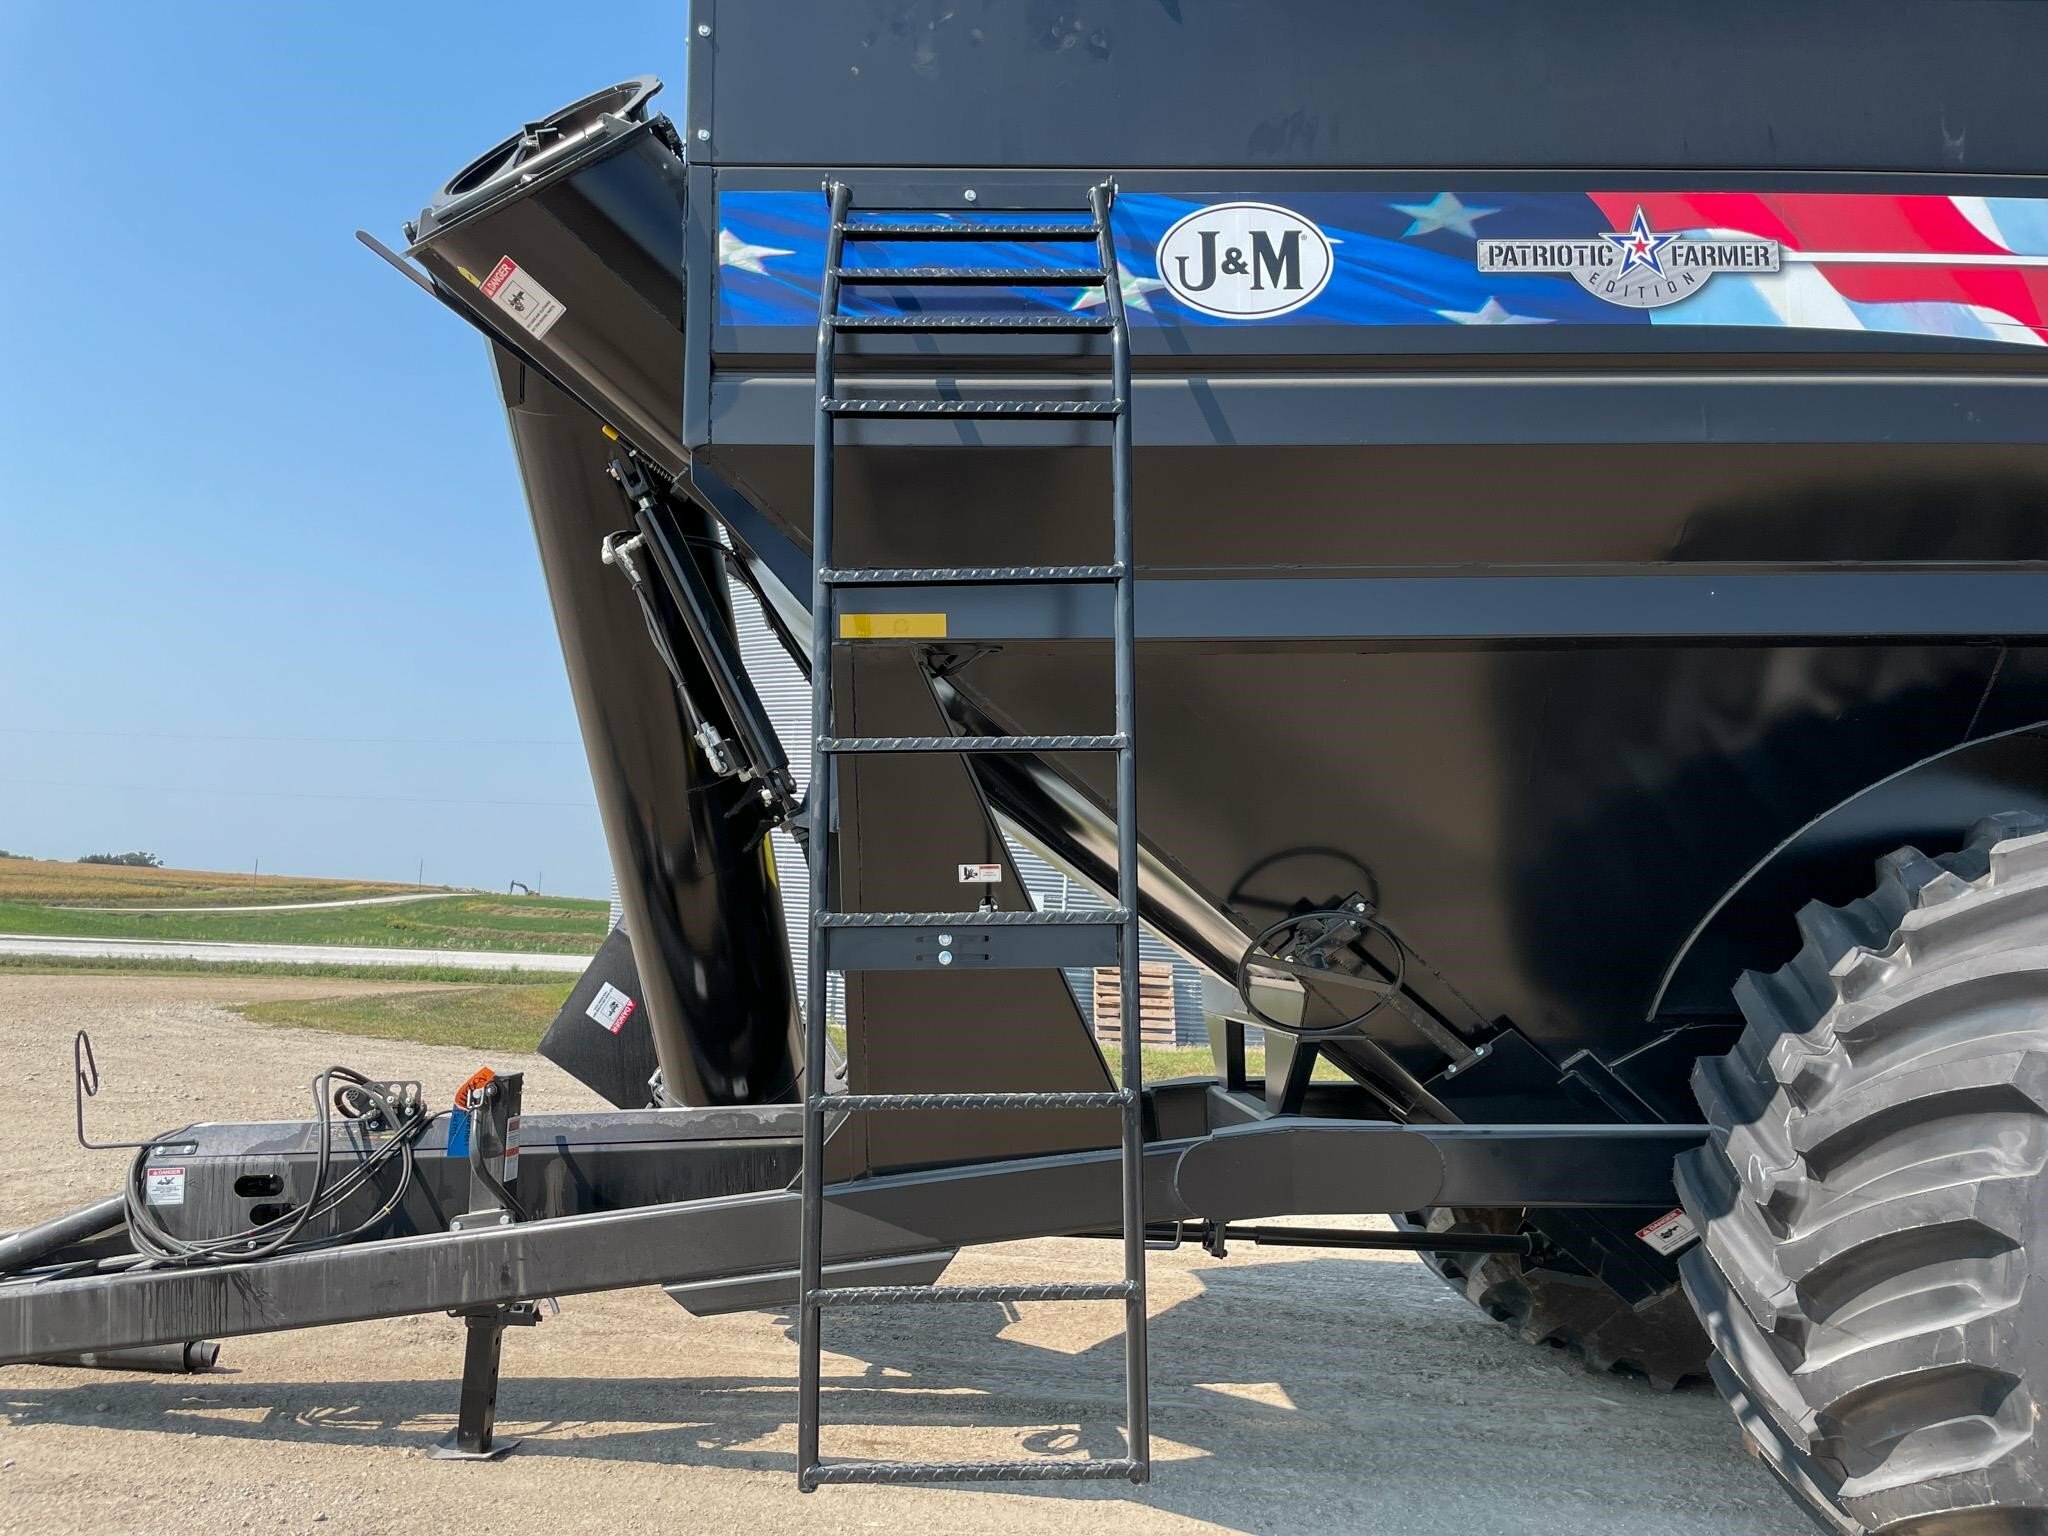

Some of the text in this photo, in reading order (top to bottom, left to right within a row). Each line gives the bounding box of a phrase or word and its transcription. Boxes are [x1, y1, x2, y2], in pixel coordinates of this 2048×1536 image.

[1175, 230, 1304, 291] J&M
[1488, 245, 1770, 267] PATRIOTIC FARMER
[487, 263, 512, 291] DANGER
[1588, 271, 1695, 299] EDITION
[611, 1006, 632, 1033] DANGER
[1649, 1212, 1678, 1231] DANGER
